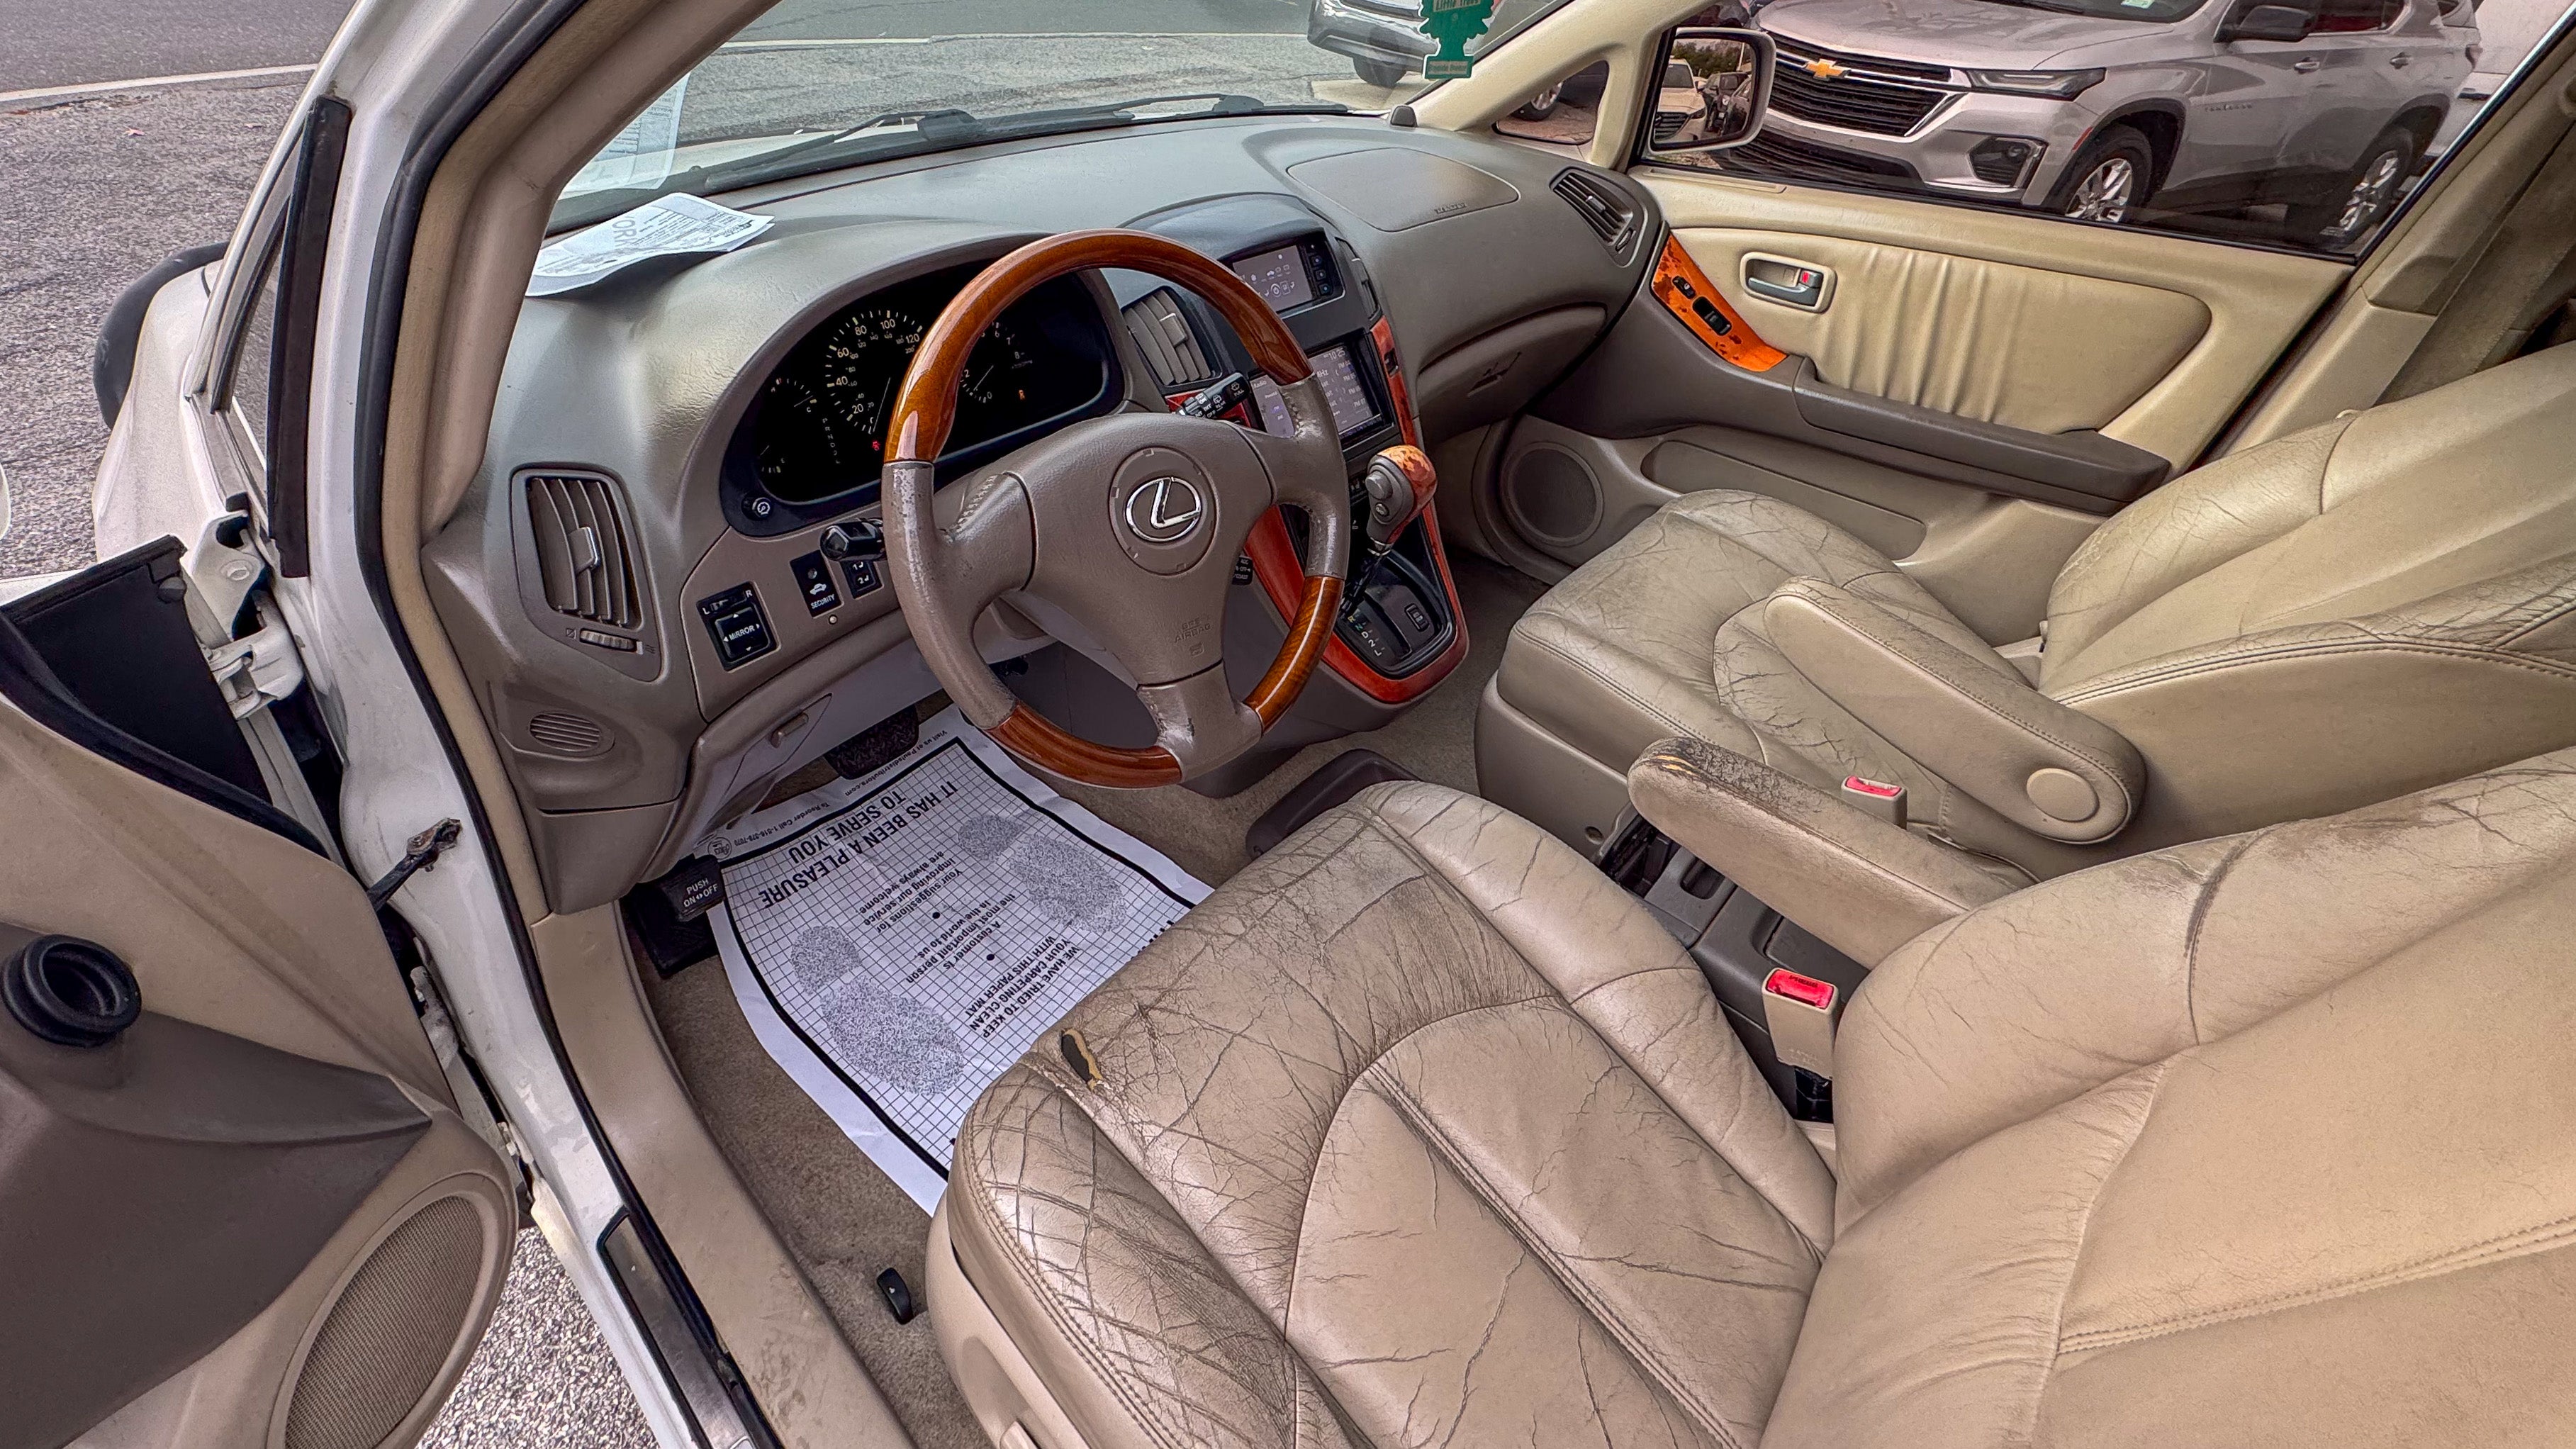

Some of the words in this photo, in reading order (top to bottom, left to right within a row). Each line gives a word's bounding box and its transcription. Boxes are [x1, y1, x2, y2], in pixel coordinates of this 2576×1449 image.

[855, 325, 867, 336] 80
[880, 318, 896, 330] 100
[905, 333, 920, 345] 120
[836, 347, 849, 358] 60
[836, 376, 849, 386] 40
[852, 403, 863, 415] 20
[745, 589, 753, 598] R
[810, 593, 835, 609] SECURITY
[729, 625, 756, 641] MIRROR
[1175, 623, 1211, 643] AIRBAG
[939, 779, 957, 798] IT
[880, 788, 905, 811] TO
[905, 790, 941, 822] HAS
[777, 818, 793, 829] Call
[827, 803, 881, 843] SERVE
[862, 812, 905, 849] BEEN
[786, 832, 828, 864] YOU
[848, 839, 863, 856] A
[926, 849, 945, 865] are
[757, 847, 849, 908] PLEASURE
[897, 858, 930, 887] always
[909, 854, 955, 892] improving
[940, 866, 963, 885] Your
[683, 895, 696, 907] ON
[702, 883, 719, 897] OFF
[686, 878, 709, 895] PUSH
[895, 887, 913, 903] our
[887, 879, 943, 924] suggestions
[978, 899, 991, 912] in
[999, 892, 1016, 908] the
[862, 898, 897, 928] service
[963, 907, 981, 922] the
[978, 904, 1002, 926] most
[875, 919, 891, 935] for
[939, 917, 968, 942] world
[990, 919, 1001, 930] A
[928, 936, 942, 950] to
[936, 920, 980, 960] important
[952, 926, 994, 963] customer
[1031, 934, 1056, 958] WITH
[1043, 935, 1070, 962] YOUR
[1062, 944, 1080, 962] WE
[905, 954, 939, 985] person
[1011, 954, 1033, 975] THIS
[1041, 957, 1067, 983] HAVE
[983, 970, 1014, 1000] PAPER
[998, 958, 1046, 1003] CARPETING
[1016, 978, 1045, 1005] TRIED
[963, 996, 987, 1019] MAT
[968, 1000, 1001, 1032] CLEAN
[1003, 1000, 1019, 1017] TO
[980, 1013, 1006, 1039] KEEP
